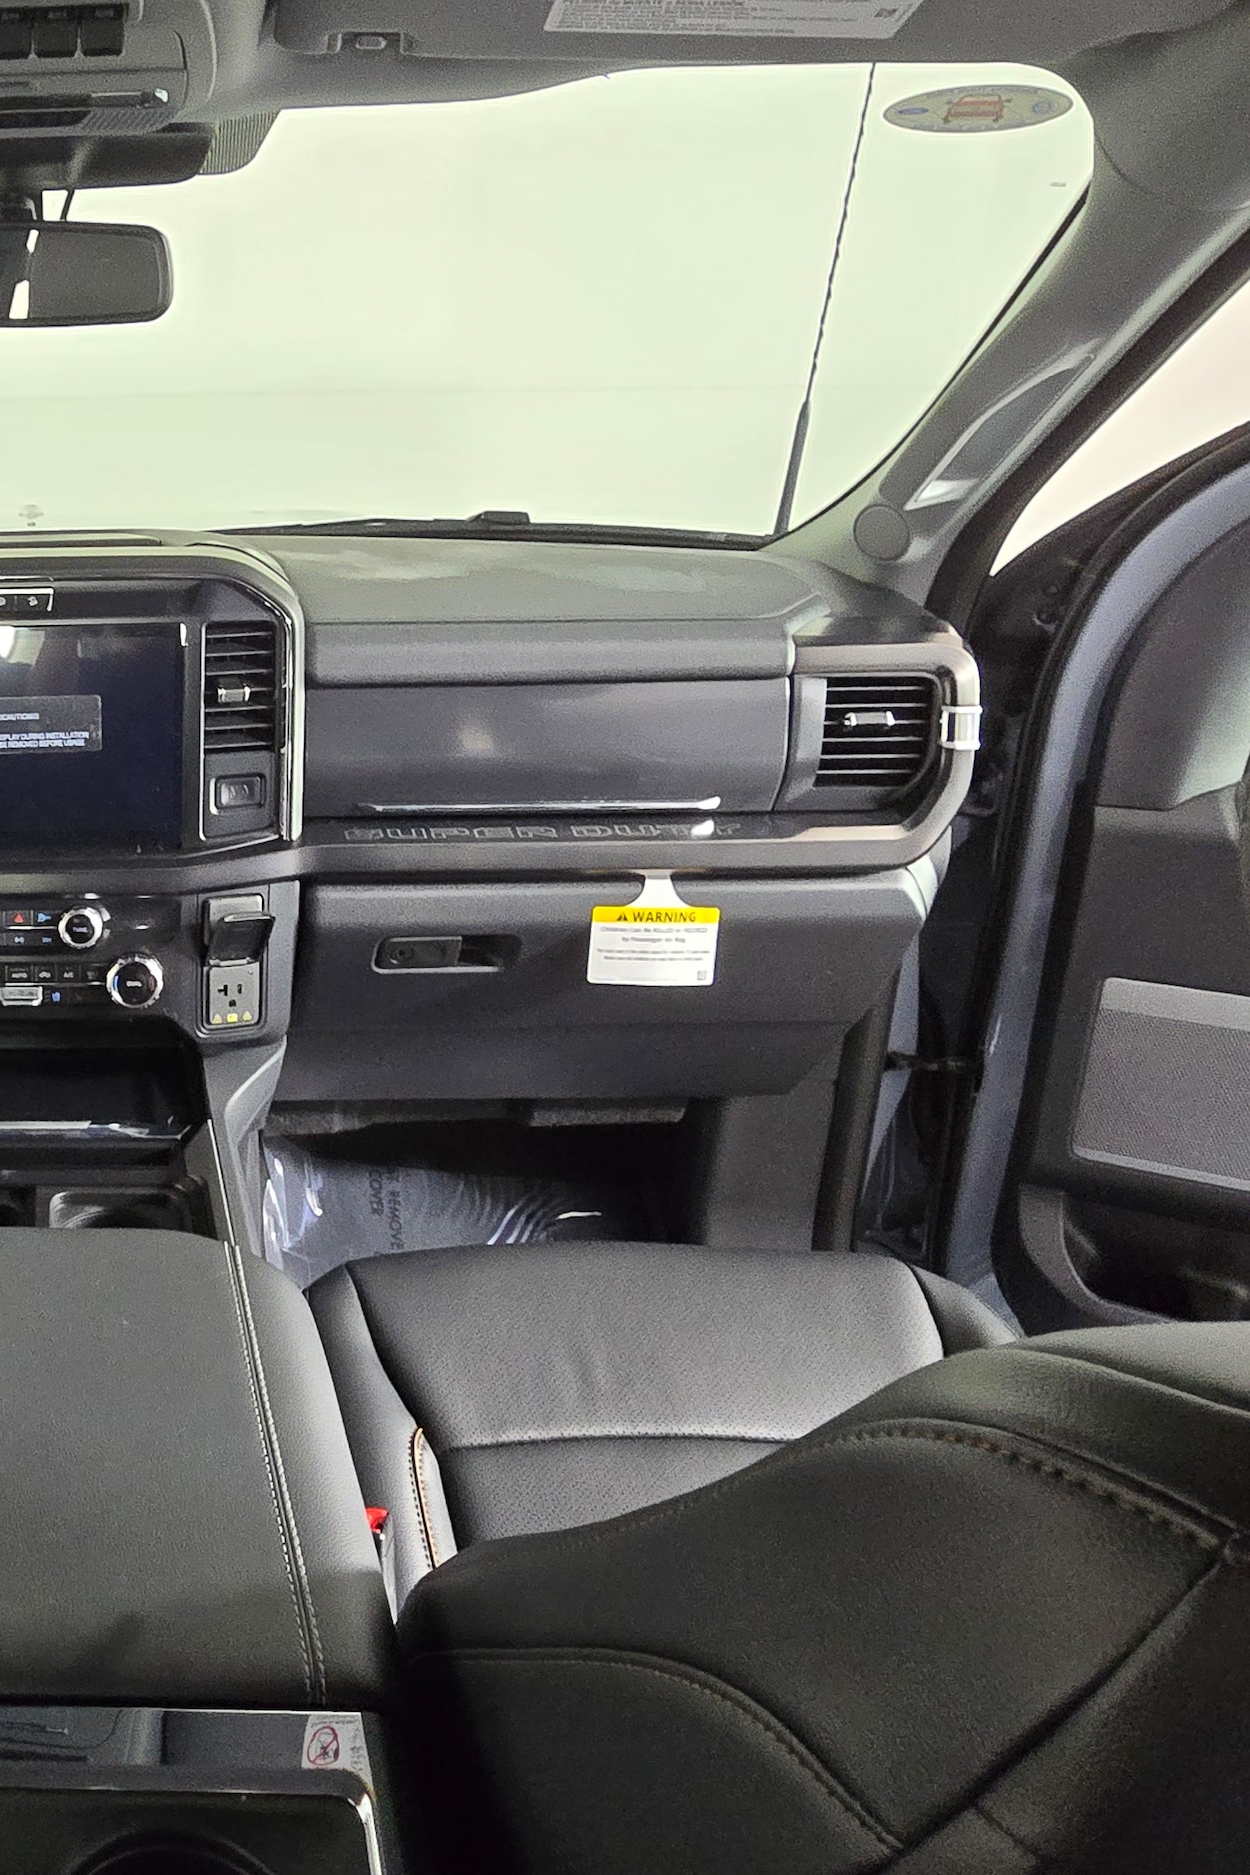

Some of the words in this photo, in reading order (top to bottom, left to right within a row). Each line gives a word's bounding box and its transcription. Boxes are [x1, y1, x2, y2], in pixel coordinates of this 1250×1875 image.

[344, 826, 558, 840] SUPER
[632, 911, 697, 923] WARNING
[368, 1168, 383, 1217] COVER
[388, 1191, 404, 1250] REMOVE
